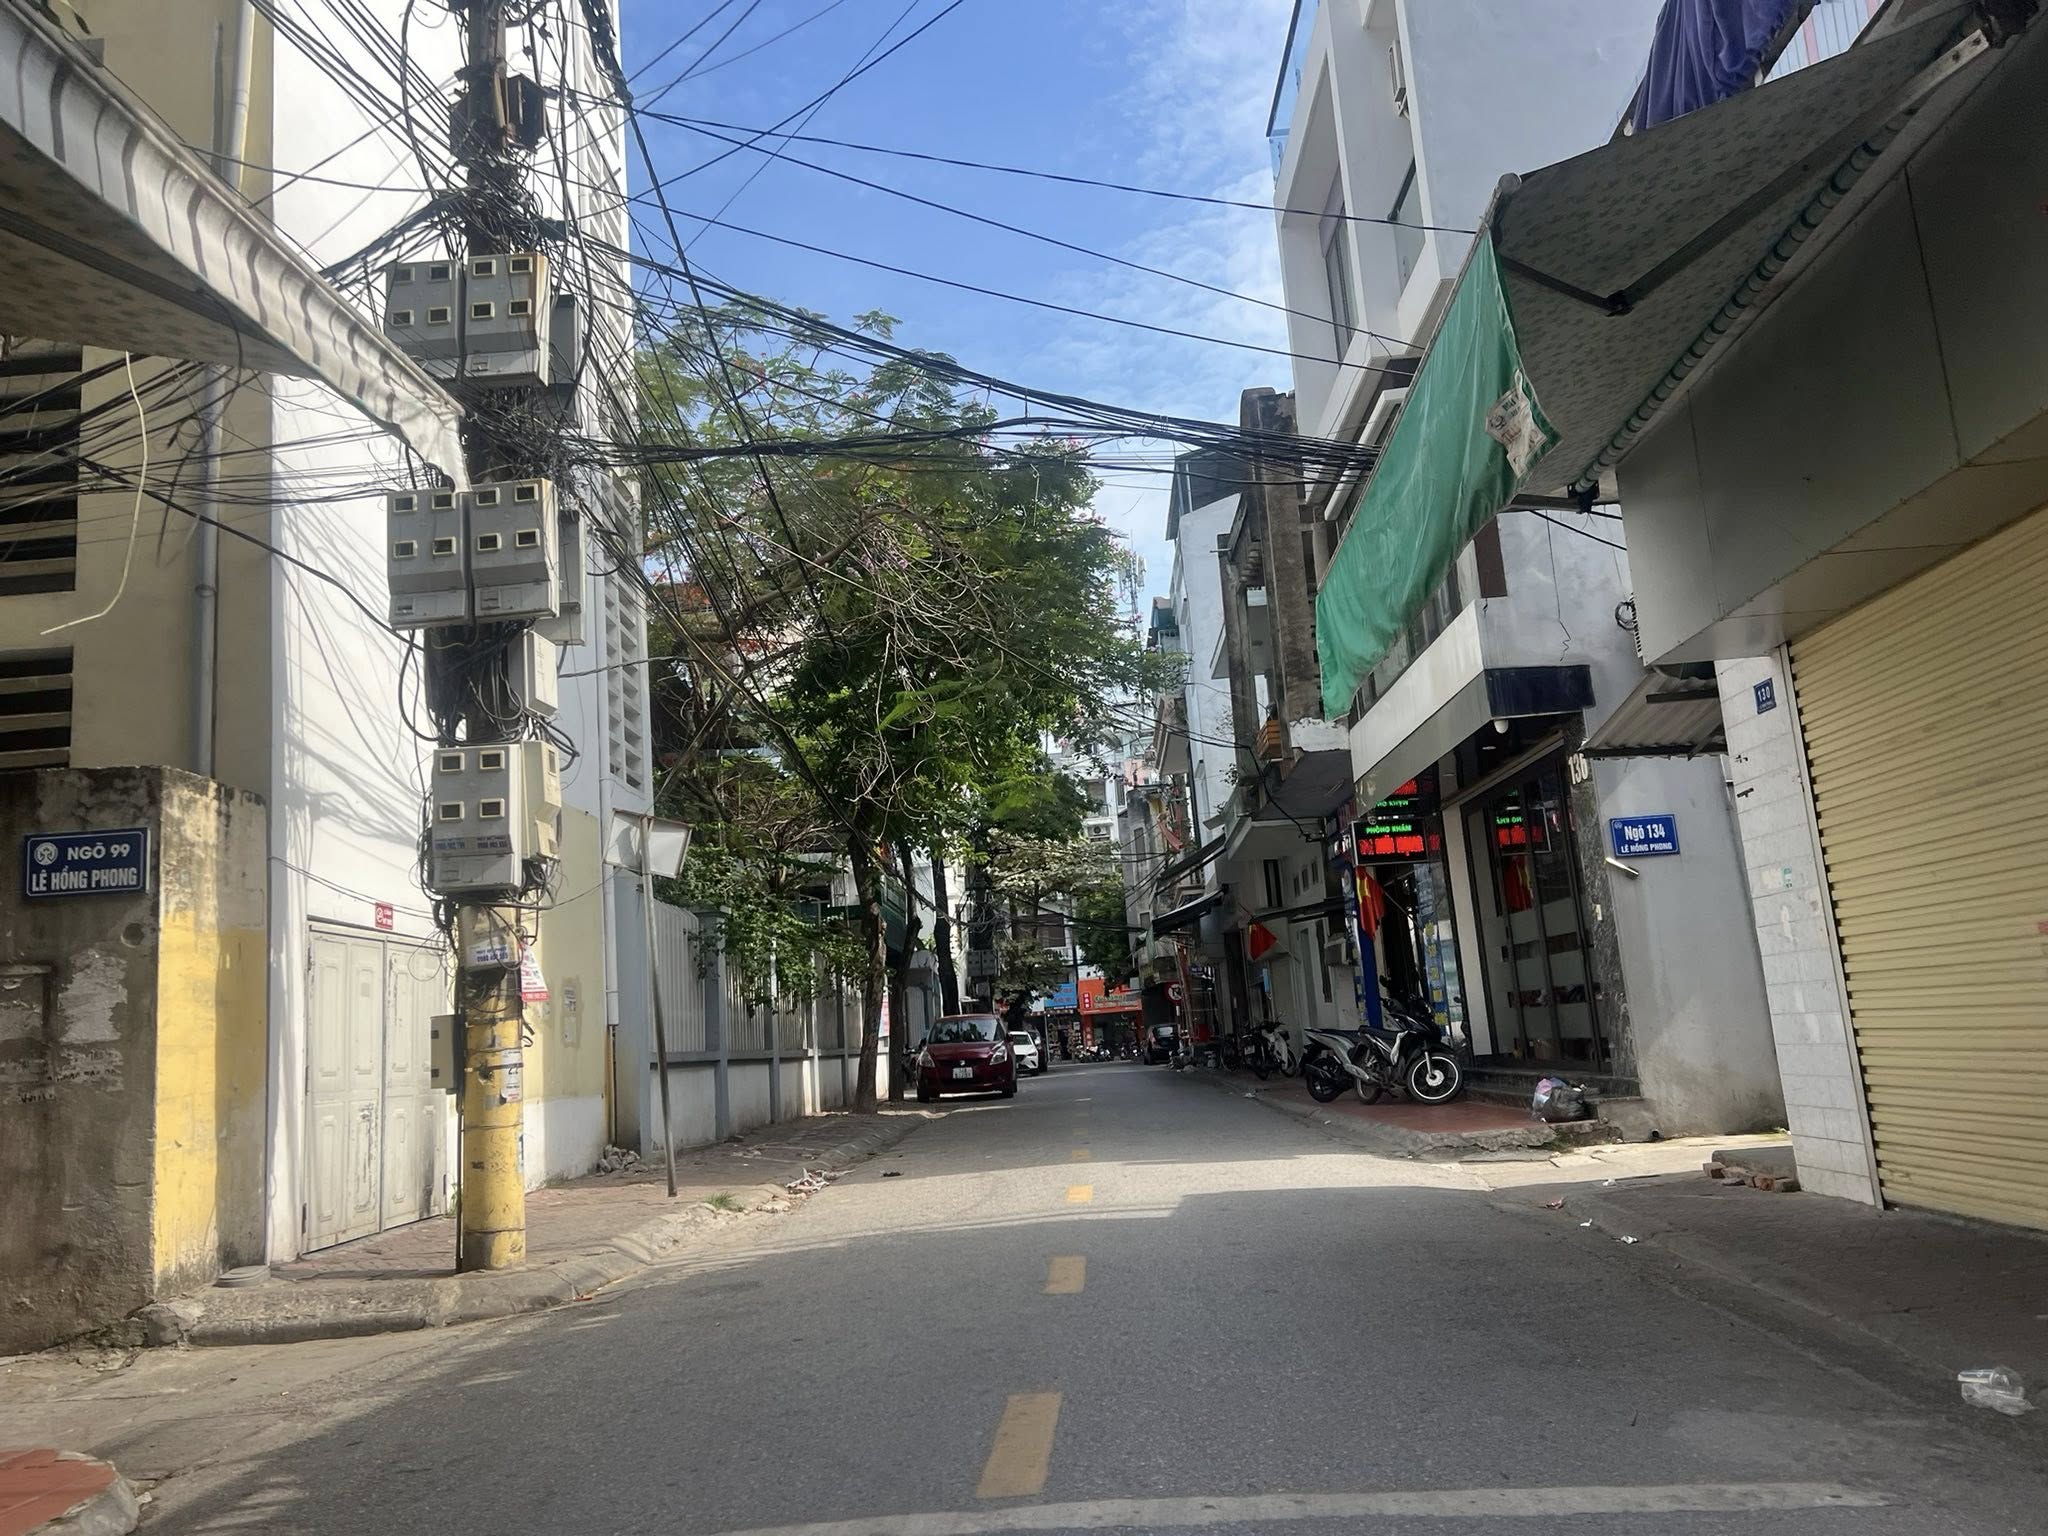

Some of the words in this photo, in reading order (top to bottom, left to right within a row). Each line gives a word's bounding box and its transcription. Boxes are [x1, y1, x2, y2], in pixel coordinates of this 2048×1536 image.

[1623, 824, 1645, 842] Ngõ
[1646, 823, 1666, 839] 134
[67, 841, 106, 861] NGÕ
[110, 842, 131, 858] 99
[1649, 841, 1673, 852] PHONG
[31, 868, 48, 892] LÊ
[51, 864, 88, 891] HỒNG
[91, 866, 138, 889] PHONG
